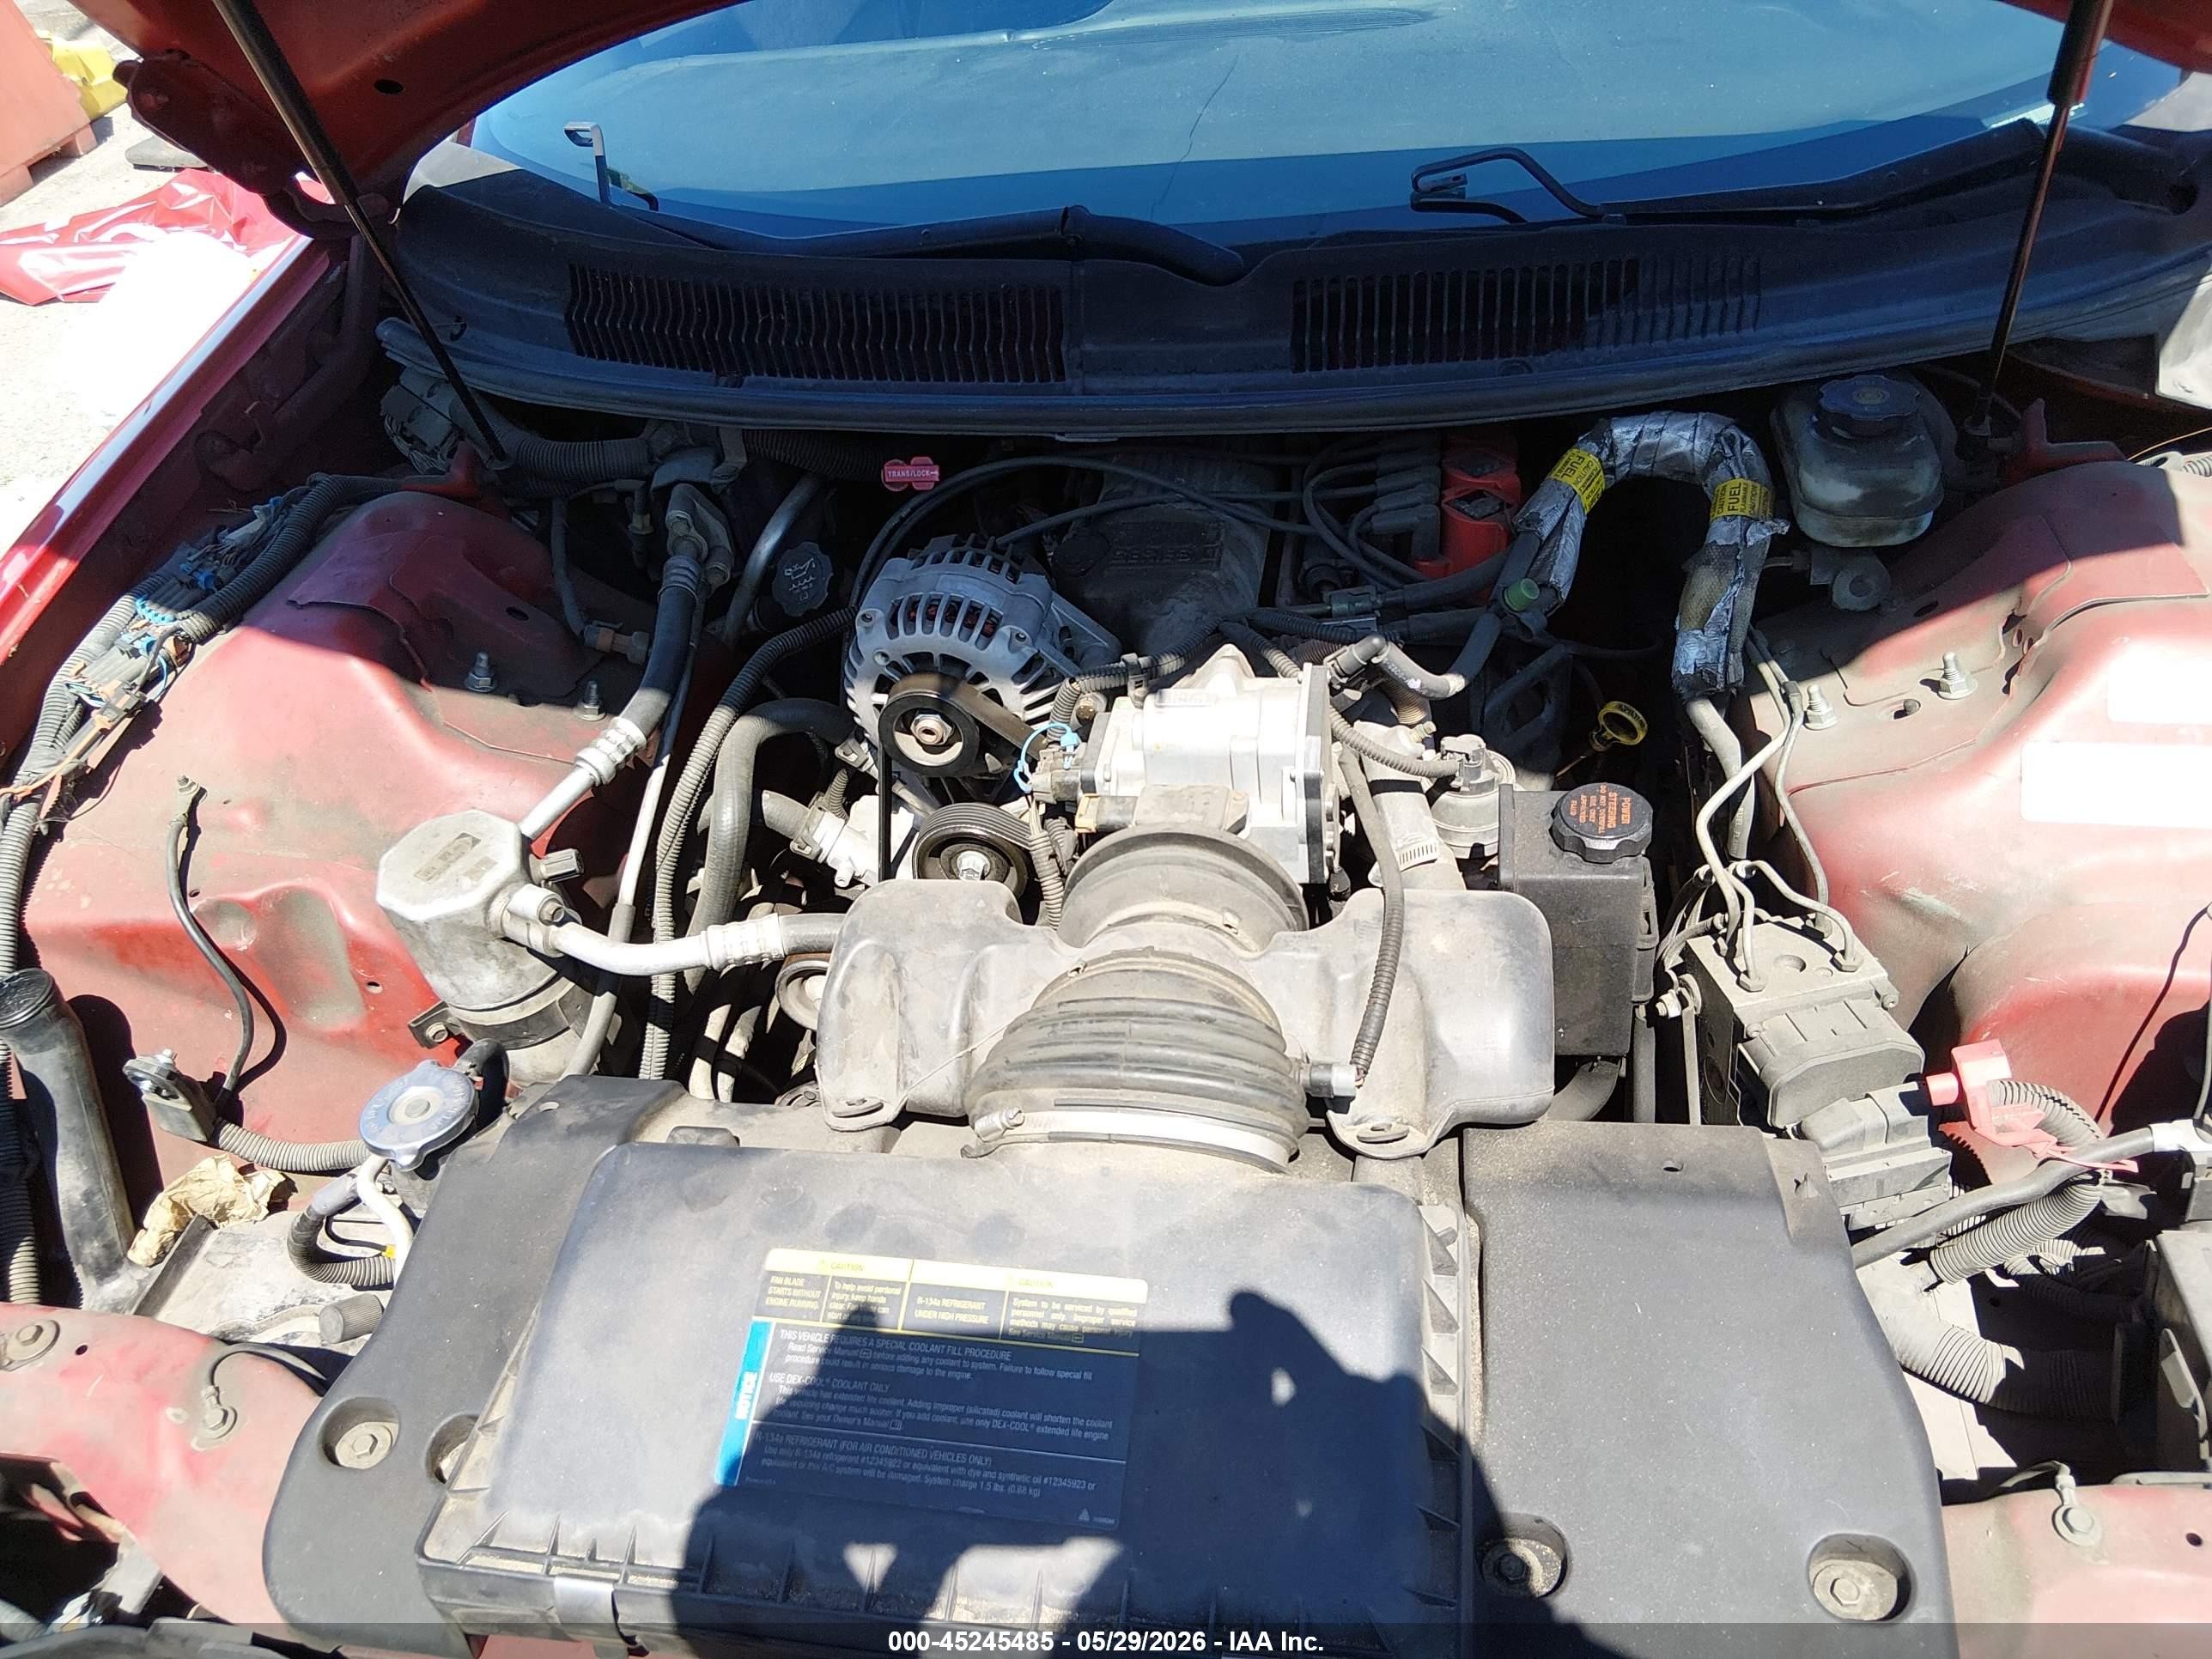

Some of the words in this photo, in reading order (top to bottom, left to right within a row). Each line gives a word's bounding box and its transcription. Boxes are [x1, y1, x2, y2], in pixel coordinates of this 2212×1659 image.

[888, 470, 931, 478] TRANS/LOCK
[1561, 456, 1585, 479] FUEL
[1728, 483, 1742, 512] FUEL
[1600, 785, 1607, 794] DO
[1599, 795, 1607, 807] NOT
[1579, 794, 1589, 824] APPROVED
[1607, 792, 1619, 829] STEERING
[1620, 796, 1632, 825] POWER
[830, 1262, 864, 1271] CAUTION
[783, 1277, 805, 1286] BLADE
[940, 1297, 986, 1310] REFRIGERANT
[1012, 1298, 1037, 1310] System
[913, 1309, 938, 1319] UNDER
[954, 1312, 989, 1323] PRESSURE
[1110, 1317, 1135, 1327] service
[1059, 1322, 1079, 1331] cause
[779, 1329, 798, 1340] THIS
[797, 1331, 829, 1343] VEHICLE
[830, 1334, 867, 1346] REQUIRES
[867, 1337, 874, 1347] A
[874, 1338, 906, 1350] SPECIAL
[908, 1341, 943, 1353] COOLANT
[945, 1345, 963, 1355] FILL
[963, 1346, 1012, 1360] PROCEDURE
[784, 1354, 819, 1367] procedure
[868, 1362, 895, 1373] serious
[933, 1369, 945, 1378] the
[787, 1341, 806, 1352] Read
[832, 1346, 860, 1358] Manual
[872, 1350, 896, 1361] before
[920, 1354, 934, 1366] any
[935, 1356, 961, 1367] coolant
[999, 1362, 1024, 1374] Failure
[1033, 1365, 1054, 1376] follow
[1055, 1368, 1082, 1381] special
[769, 1371, 787, 1382] USE
[831, 1377, 868, 1390] COOLANT
[868, 1382, 890, 1393] ONLY
[1029, 1411, 1042, 1422] will
[1072, 1416, 1085, 1426] the
[974, 1418, 991, 1429] only
[1035, 1425, 1070, 1436] extended
[1070, 1428, 1083, 1437] life
[1083, 1430, 1109, 1442] engine
[755, 1431, 784, 1443] R-134a
[784, 1433, 838, 1449] REFRIGERANT
[838, 1439, 859, 1452] (FOR
[858, 1442, 872, 1453] AIR
[872, 1443, 927, 1459] CONDITIONED
[928, 1449, 968, 1463] VEHICLES
[968, 1453, 993, 1467] ONLY)
[763, 1444, 778, 1455] Use
